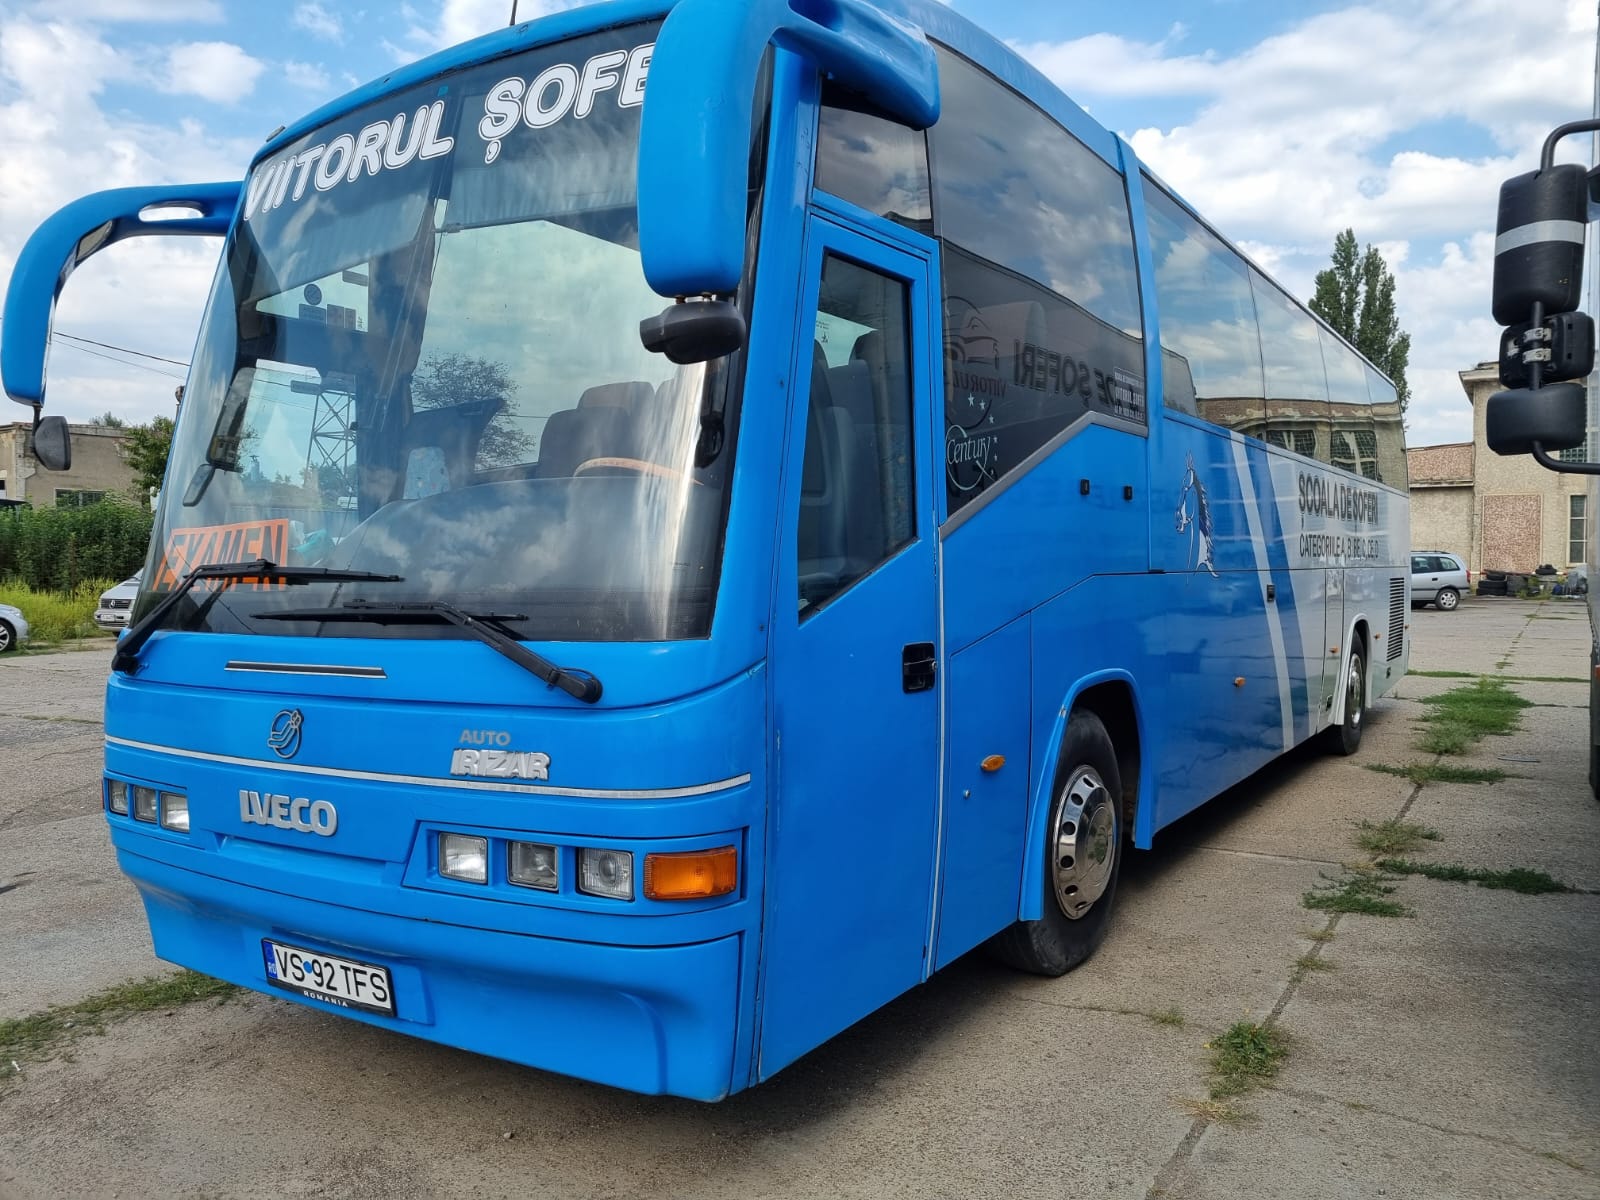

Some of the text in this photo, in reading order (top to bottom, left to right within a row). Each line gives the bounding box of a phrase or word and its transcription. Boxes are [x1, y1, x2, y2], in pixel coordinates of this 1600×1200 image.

[243, 100, 454, 221] VIITORUL
[946, 435, 991, 470] Century
[1340, 484, 1353, 521] DE
[459, 729, 511, 746] AUTO
[450, 748, 551, 780] IRIZAR
[239, 790, 338, 837] IVECO
[303, 990, 349, 1008] ROMANIA
